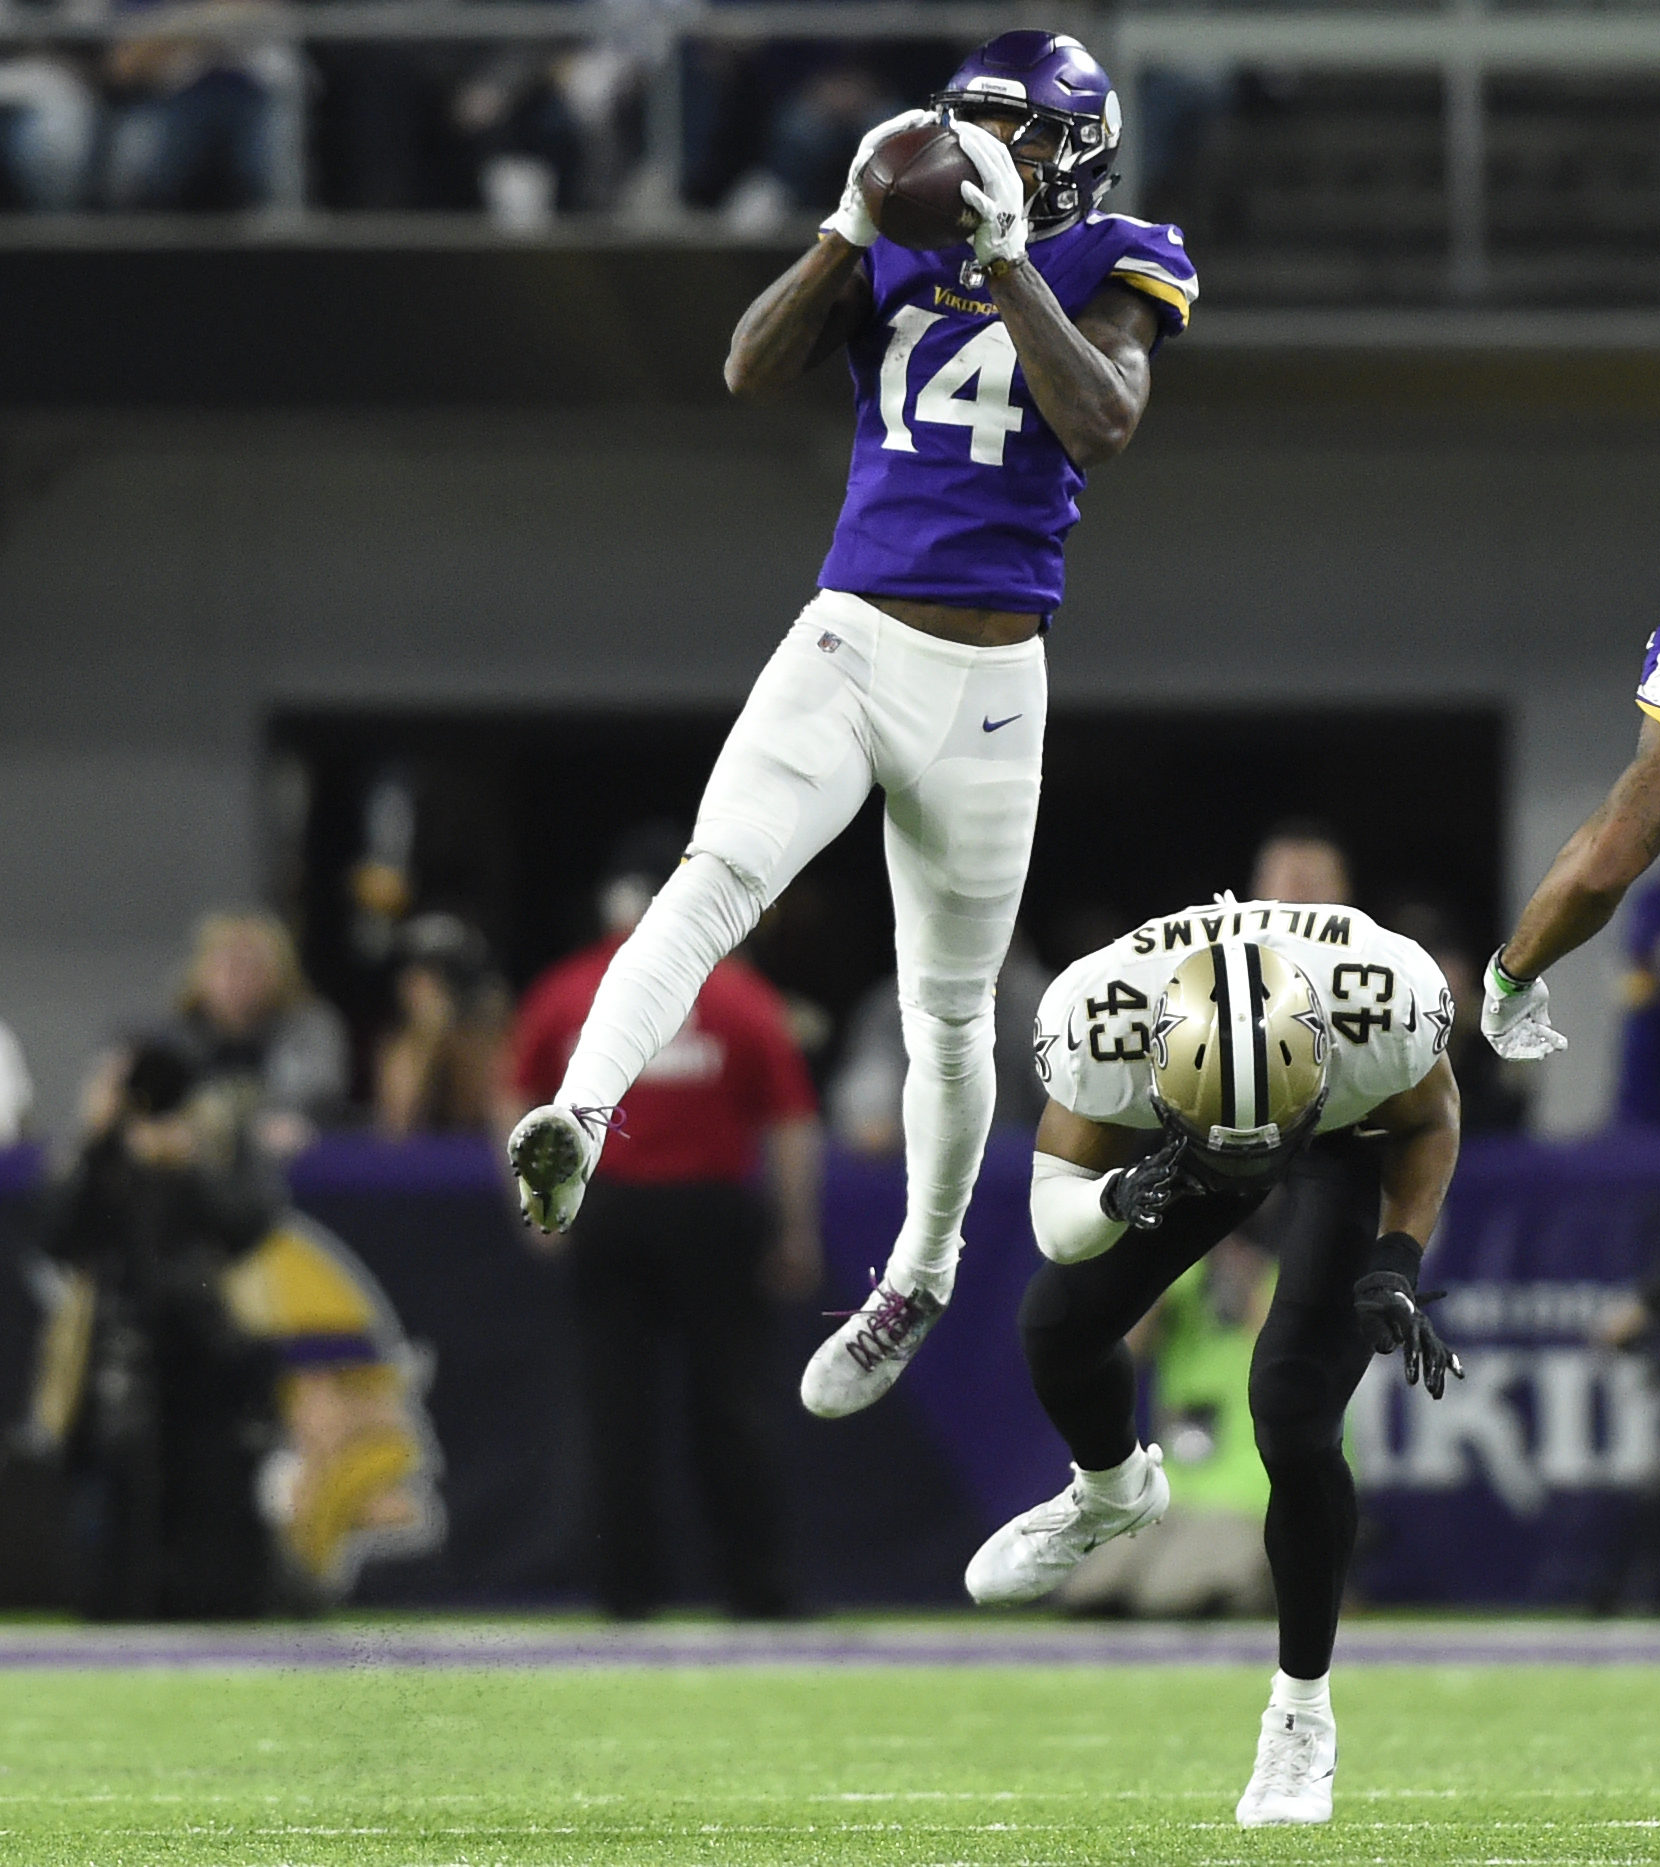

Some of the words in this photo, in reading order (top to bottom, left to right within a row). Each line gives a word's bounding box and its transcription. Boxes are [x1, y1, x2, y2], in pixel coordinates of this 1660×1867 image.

[880, 304, 1024, 467] 14
[1132, 908, 1351, 955] WILLIAMS
[1086, 979, 1152, 1063] 43
[1330, 962, 1394, 1045] 43
